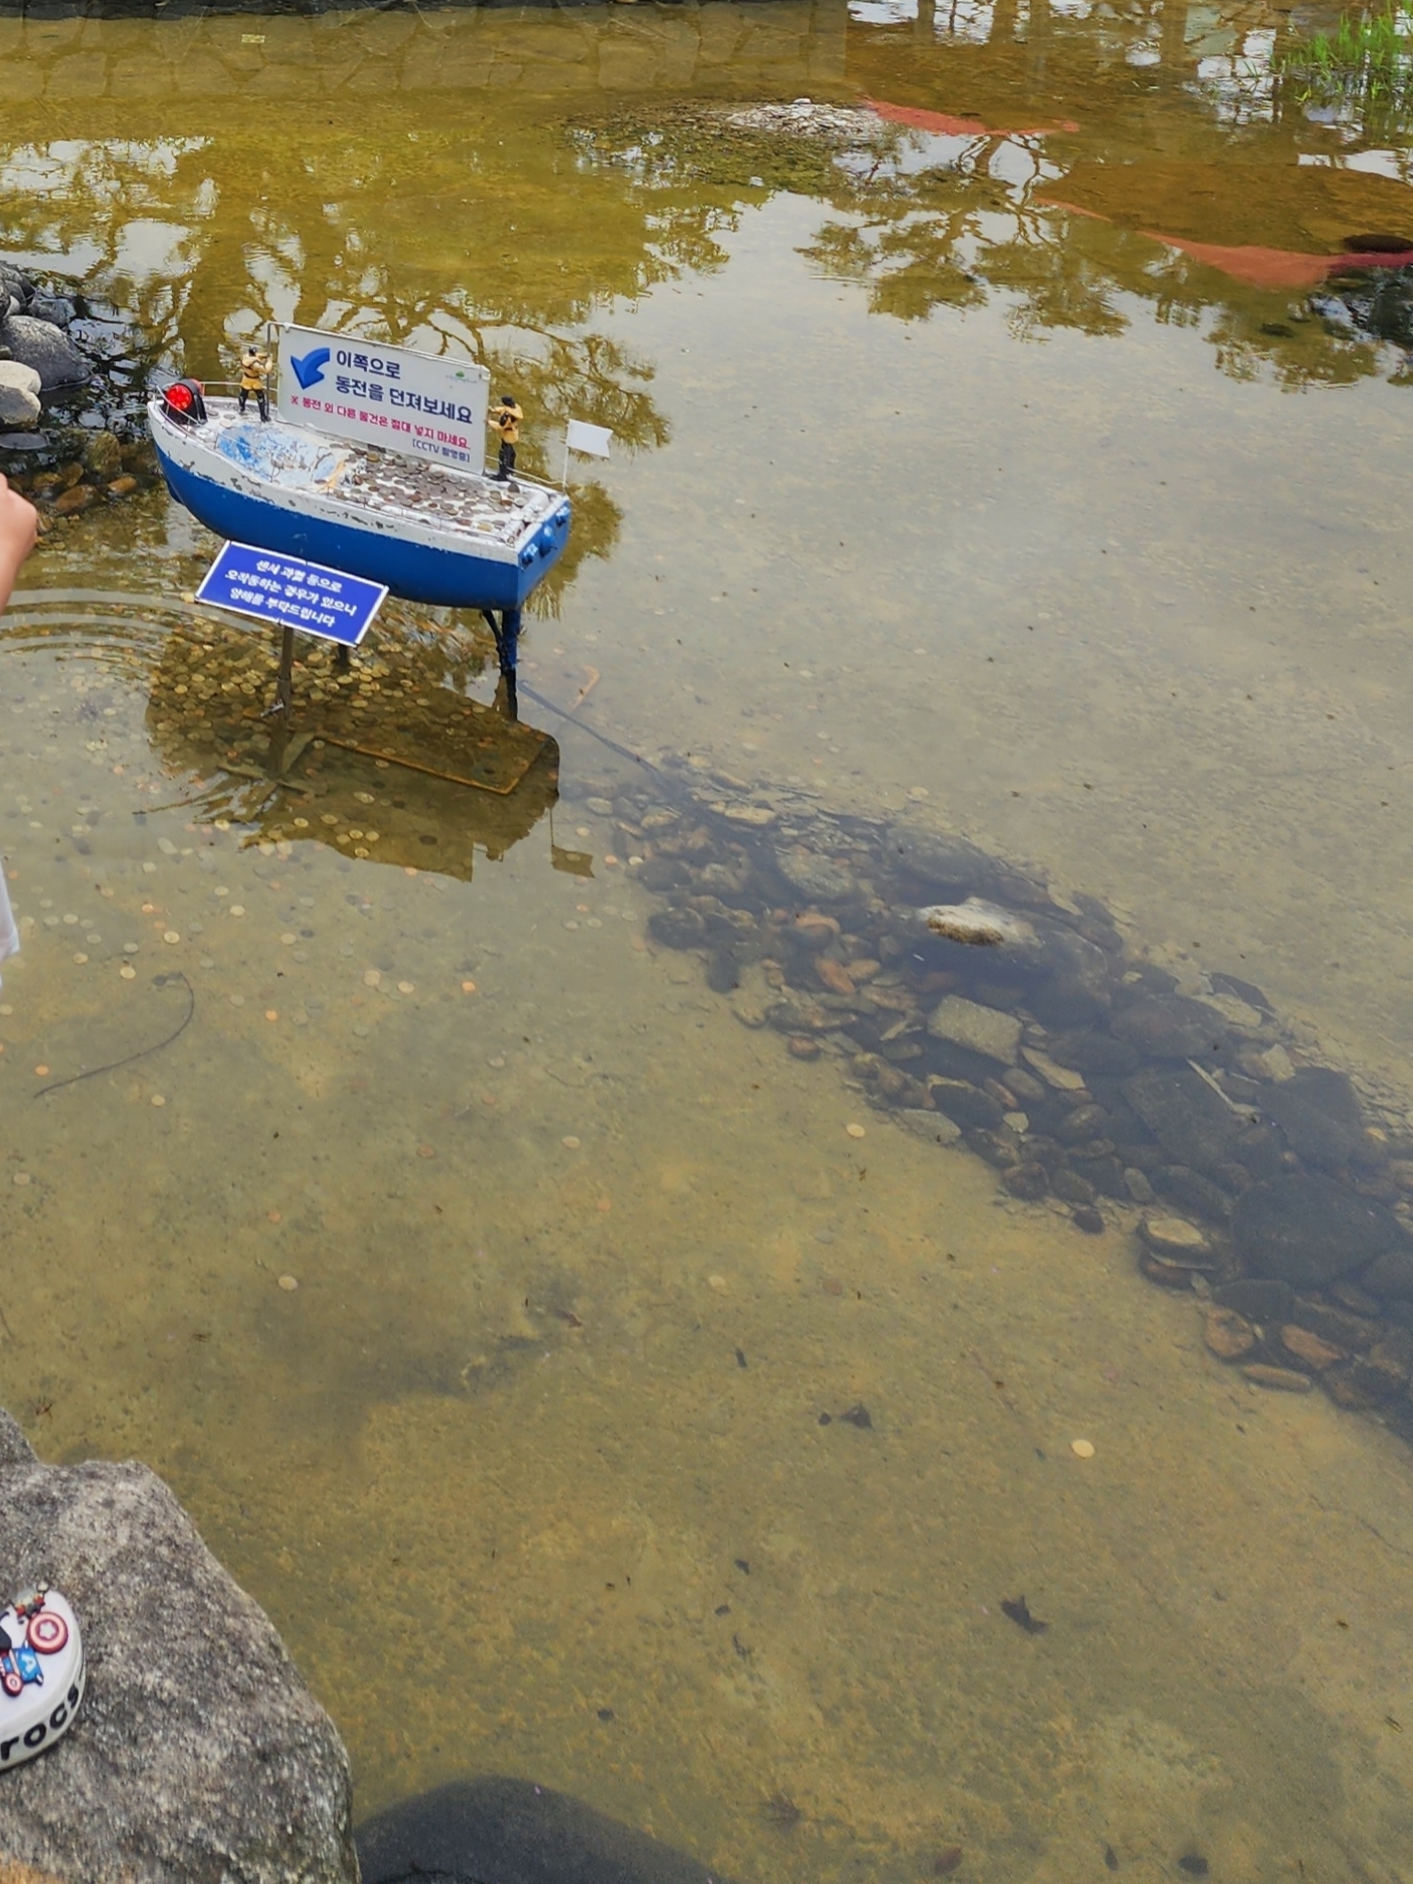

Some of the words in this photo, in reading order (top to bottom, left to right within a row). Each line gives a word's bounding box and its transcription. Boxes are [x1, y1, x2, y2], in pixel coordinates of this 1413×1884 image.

[336, 350, 401, 380] 이쪽으로
[302, 397, 321, 411] 동전
[324, 402, 334, 414] 외
[337, 405, 356, 420] 다른
[359, 410, 388, 428] 물건은
[391, 418, 411, 433] 절대
[335, 375, 384, 402] 동전을
[389, 387, 473, 425] 던져보세요
[224, 569, 282, 594] 오작동하는
[284, 584, 320, 605] 경우가
[320, 596, 358, 617] 있으니
[256, 559, 281, 576] 센서
[280, 566, 307, 583] 과열
[307, 573, 343, 594] 등으로
[229, 586, 265, 607] 양해를
[265, 596, 336, 628] 부탁드립니다
